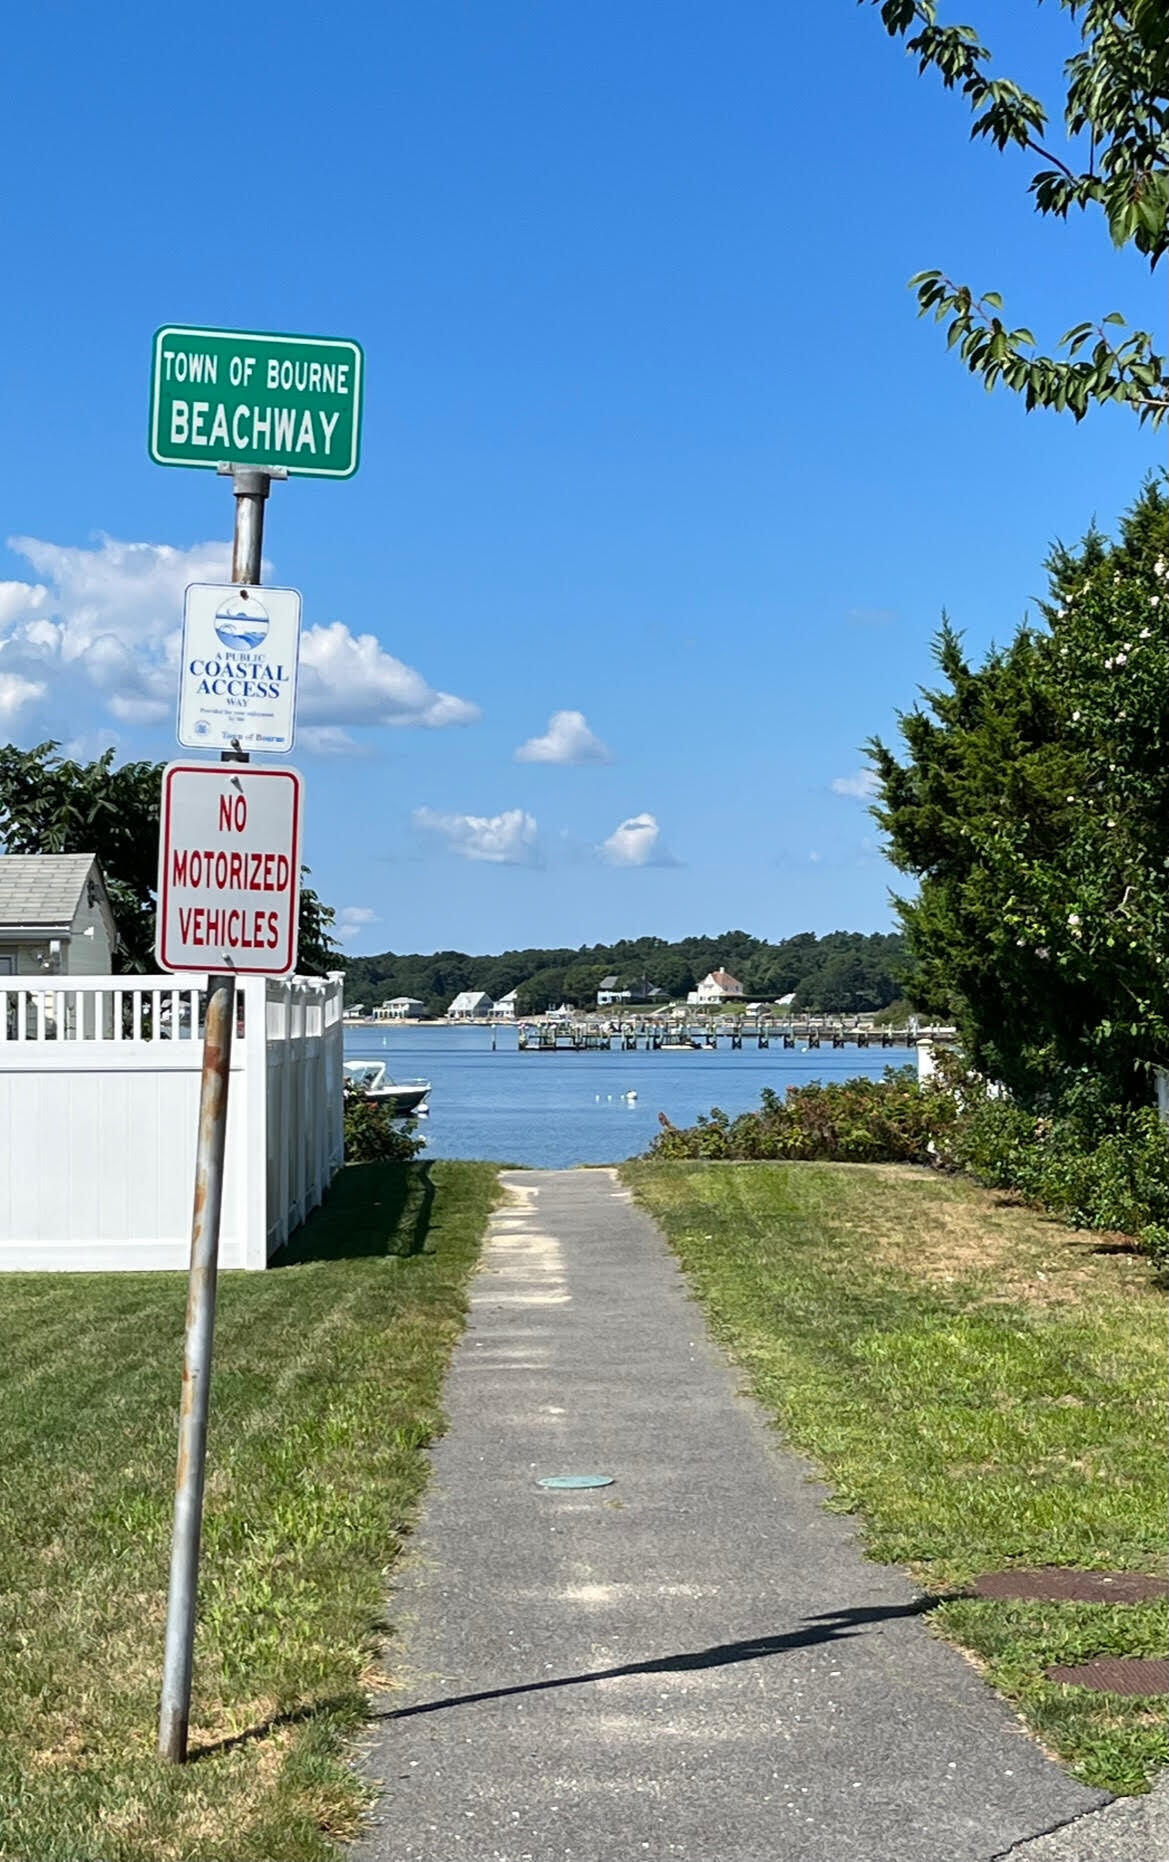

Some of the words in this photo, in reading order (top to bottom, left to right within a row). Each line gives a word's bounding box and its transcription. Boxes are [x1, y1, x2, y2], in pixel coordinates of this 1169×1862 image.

[163, 351, 218, 384] TOWN
[229, 356, 256, 386] OF
[266, 359, 349, 394] BOURNE
[170, 399, 340, 455] BEACHWAY
[189, 659, 289, 681] COASTAL
[216, 652, 223, 660] A
[225, 652, 266, 662] PUBLIC
[196, 679, 280, 699] ACCESS
[226, 698, 249, 707] WAY
[222, 731, 243, 740] Town
[219, 793, 247, 832] NO
[172, 849, 289, 892] MOTORIZED
[178, 907, 279, 949] VEHICLES
